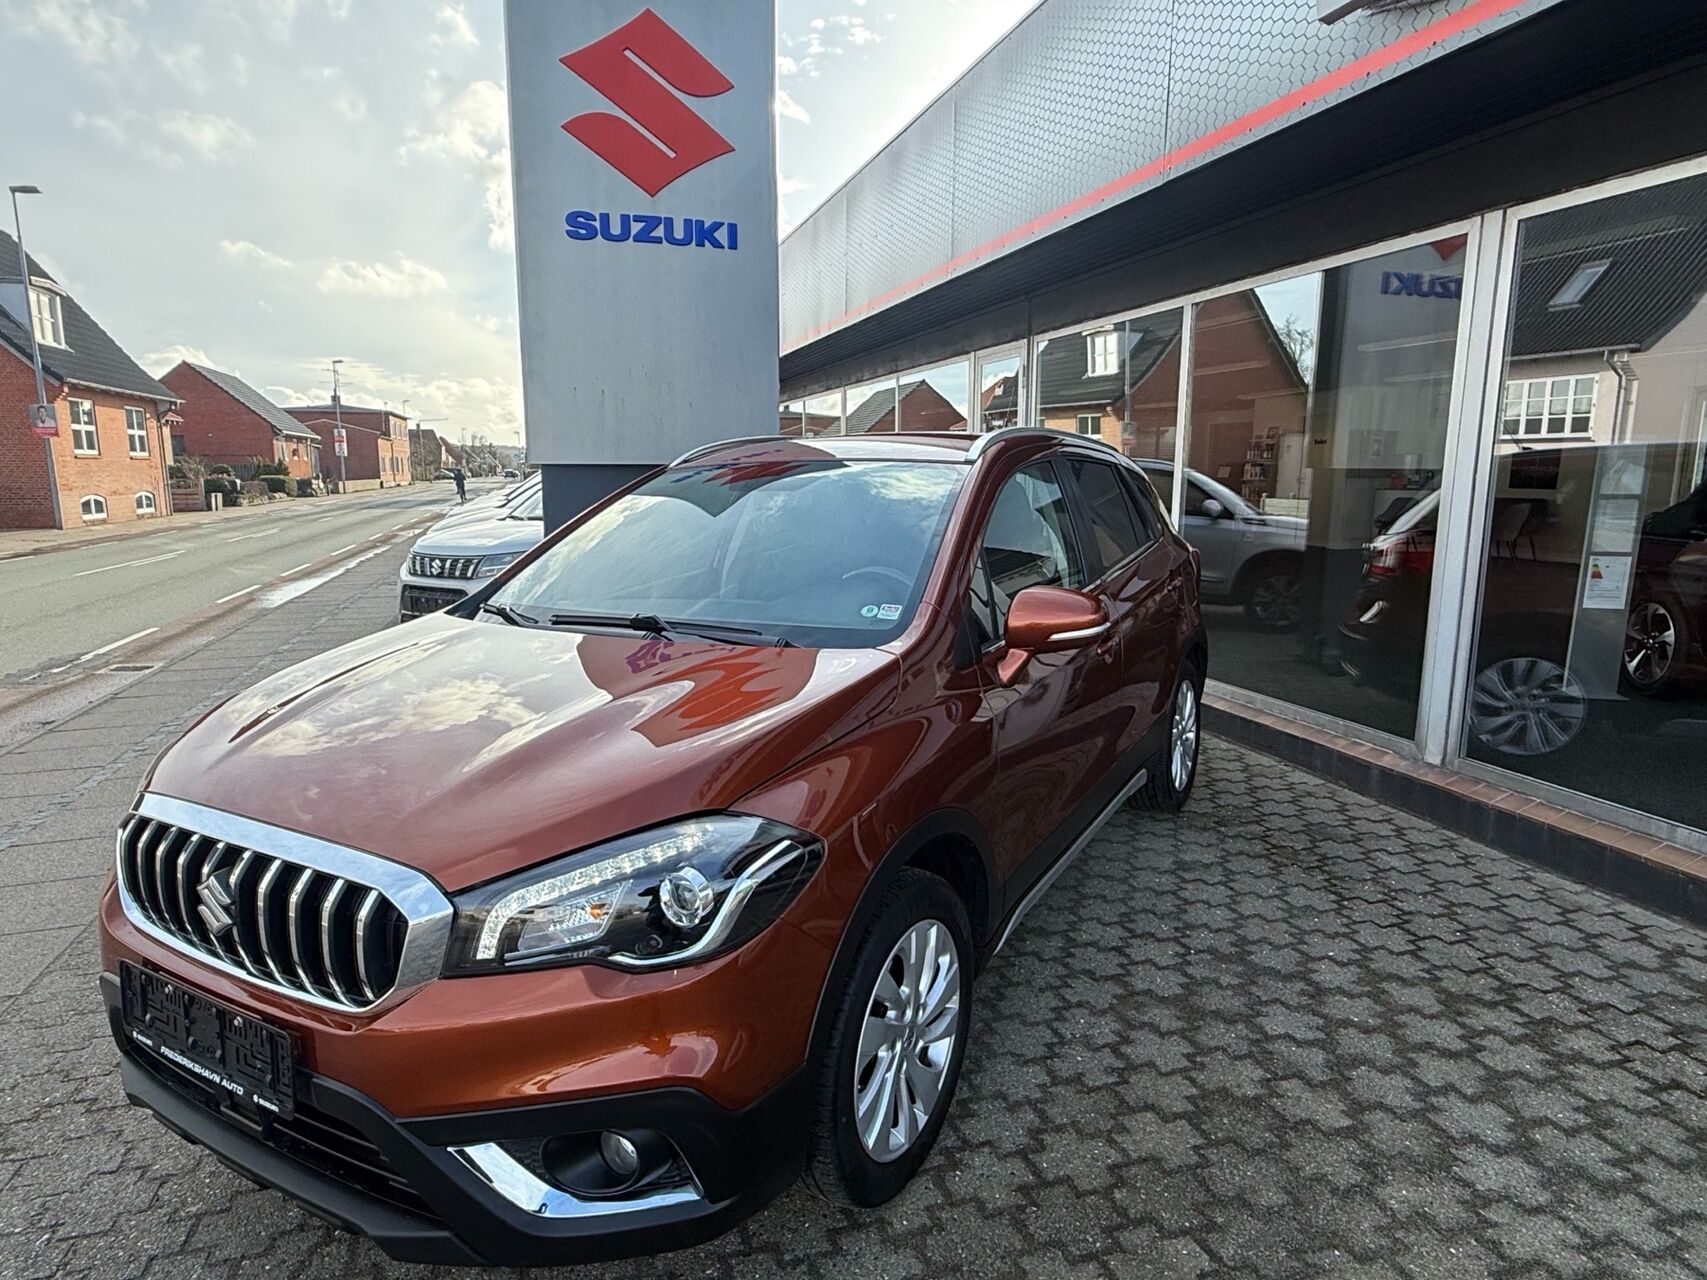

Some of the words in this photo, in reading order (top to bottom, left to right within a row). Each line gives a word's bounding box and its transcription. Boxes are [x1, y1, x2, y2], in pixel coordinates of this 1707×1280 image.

[565, 210, 738, 250] SUZUKI
[160, 1045, 221, 1084] FREDERIKSHAVN
[221, 1078, 244, 1095] AUTO
